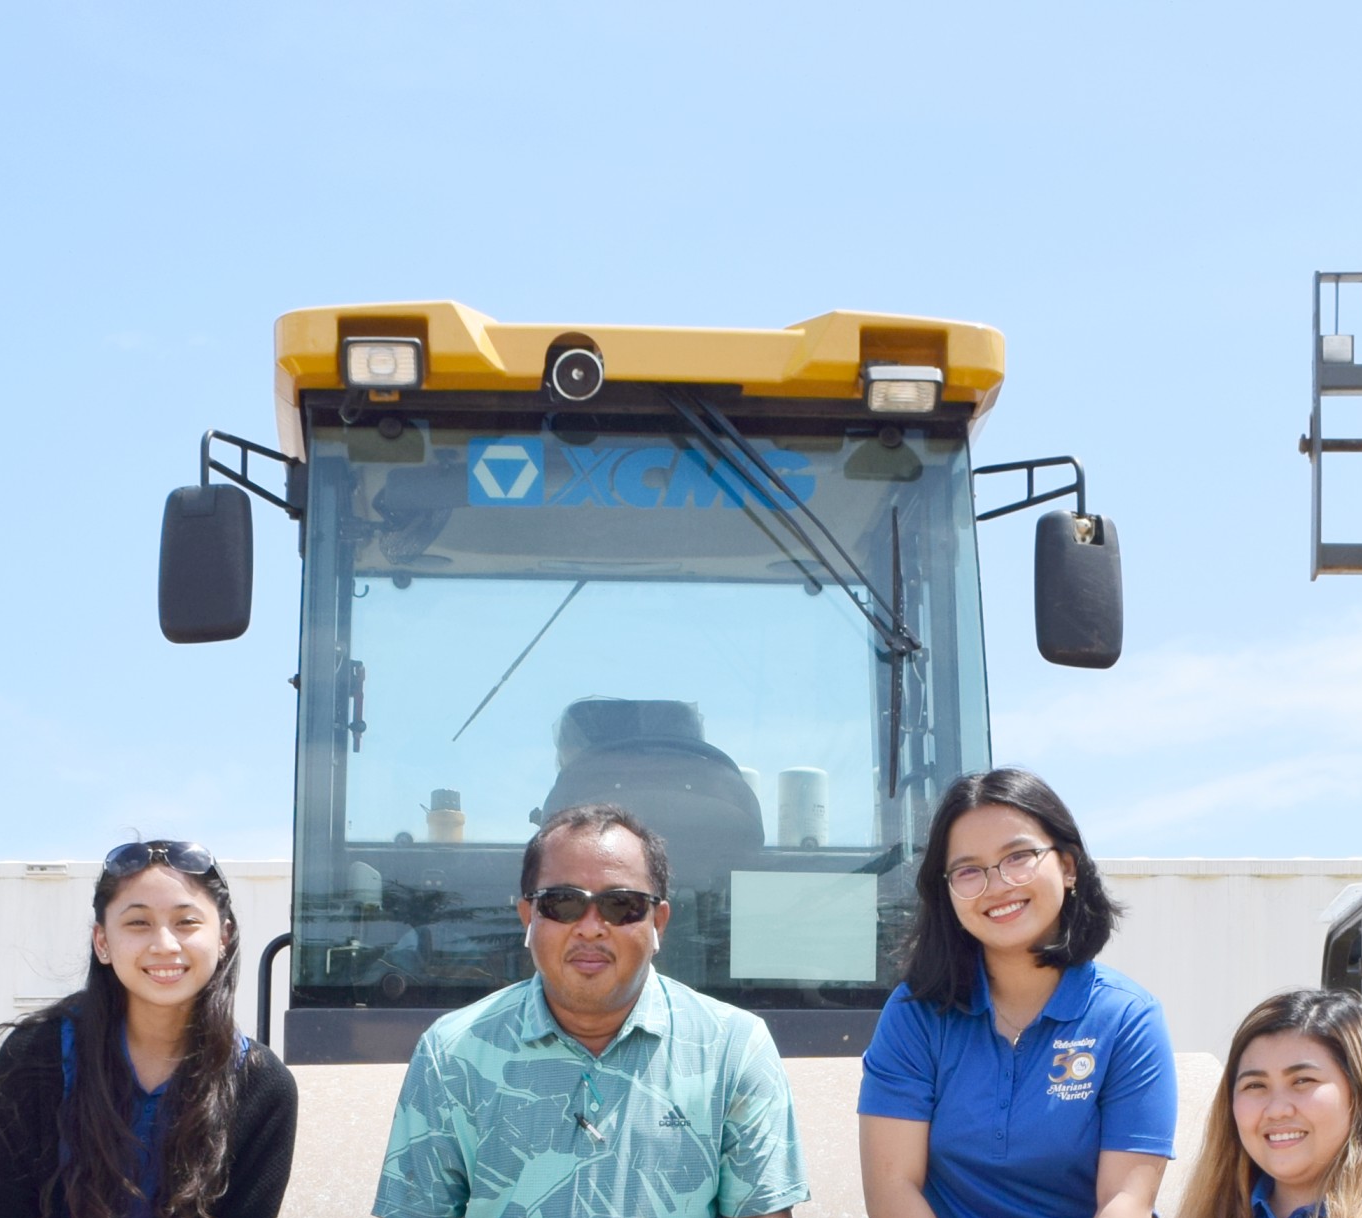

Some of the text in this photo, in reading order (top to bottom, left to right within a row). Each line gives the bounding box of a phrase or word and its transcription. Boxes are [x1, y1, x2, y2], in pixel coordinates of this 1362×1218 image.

[546, 447, 817, 509] XCMG
[1048, 1048, 1095, 1083] 50
[1047, 1082, 1092, 1095] Marianas
[1057, 1091, 1094, 1100] Variety
